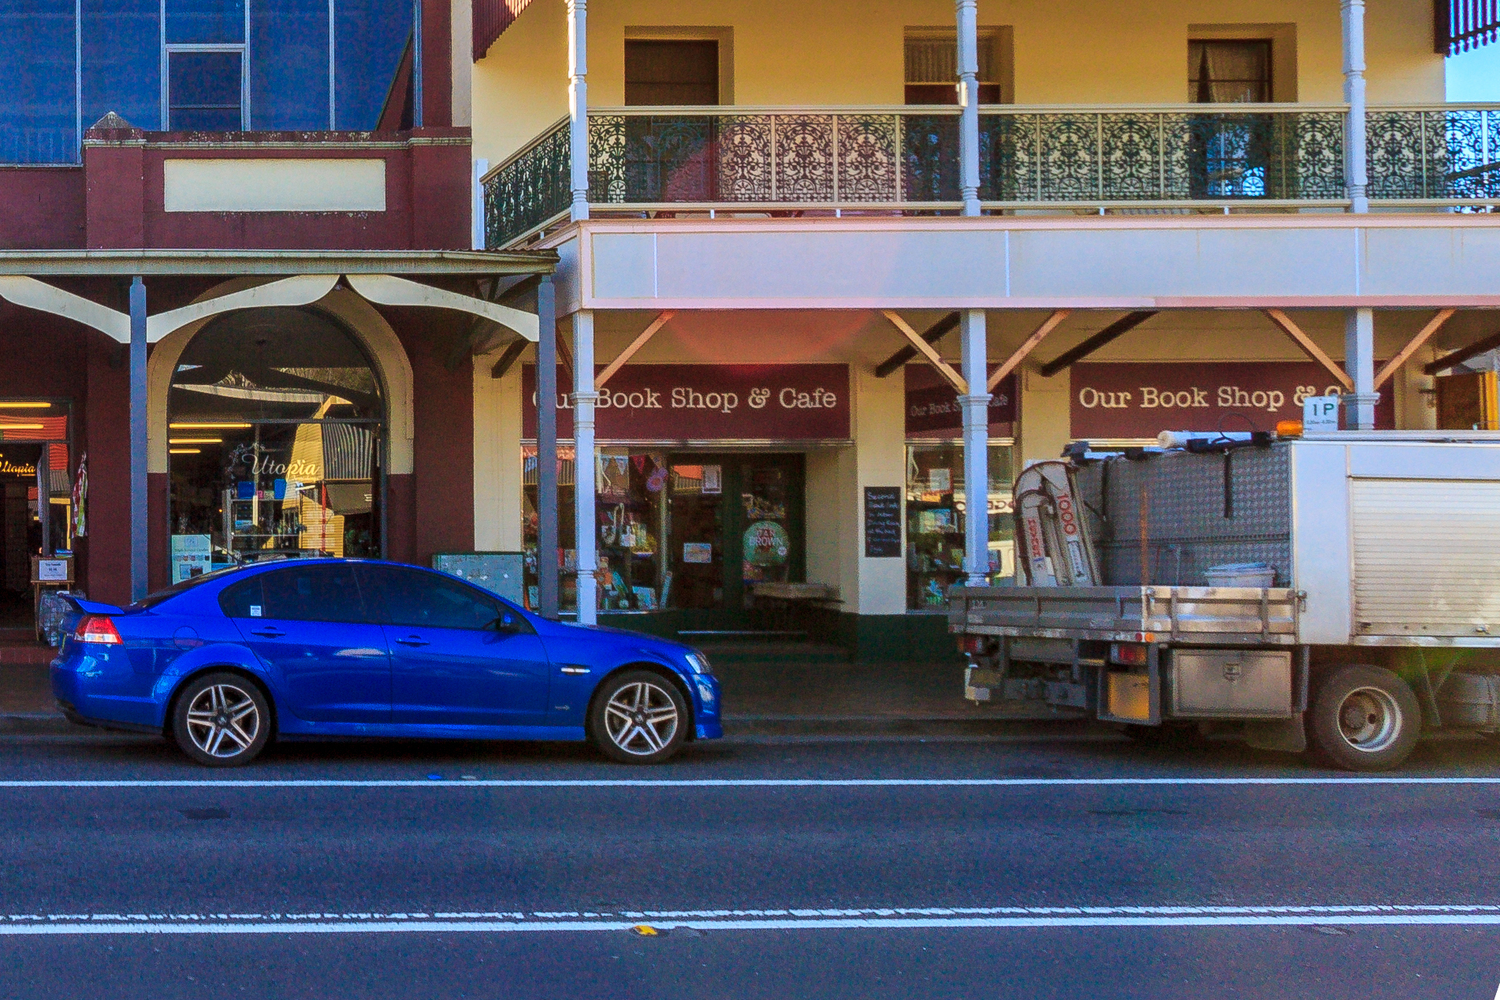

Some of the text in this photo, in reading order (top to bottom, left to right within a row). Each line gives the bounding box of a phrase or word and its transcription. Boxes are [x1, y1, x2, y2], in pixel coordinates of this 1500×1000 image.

[594, 387, 662, 409] Book
[671, 387, 739, 413] Shop
[748, 388, 771, 408] &
[779, 387, 837, 409] Cafe
[1079, 388, 1132, 408] Our
[1139, 387, 1209, 408] Book
[1217, 386, 1284, 412] Shop
[1293, 386, 1316, 407] &
[1057, 494, 1077, 535] 1000
